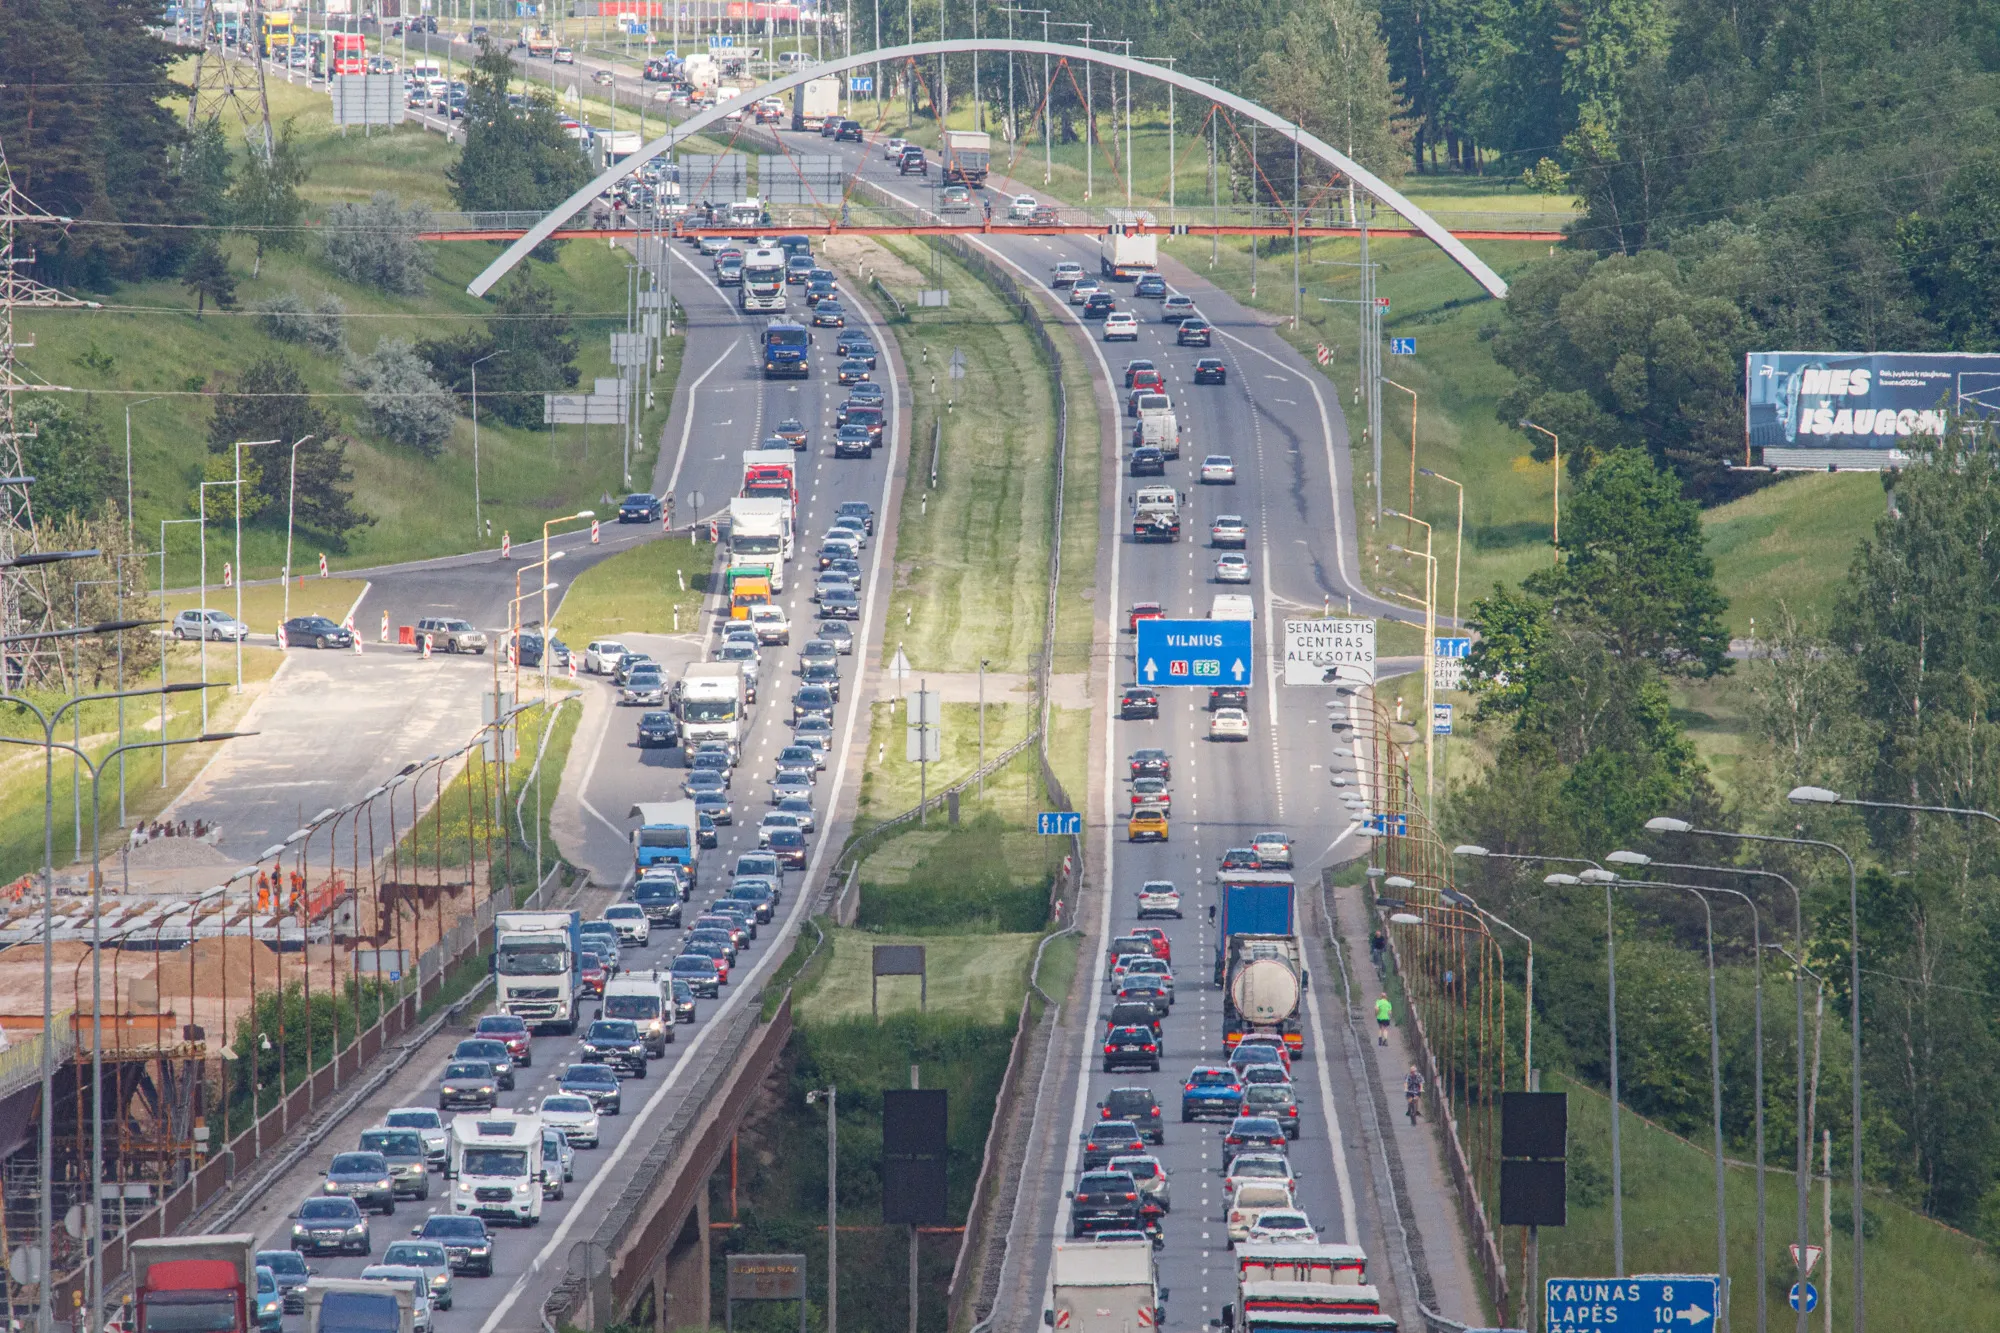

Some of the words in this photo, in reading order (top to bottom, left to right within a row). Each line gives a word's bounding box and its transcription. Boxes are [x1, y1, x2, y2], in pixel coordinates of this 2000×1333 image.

[1801, 369, 1871, 395] MES
[1287, 623, 1374, 635] SENAMIESTIS
[1167, 634, 1223, 647] VILNIUS
[1297, 636, 1363, 648] CENTRAS
[1287, 650, 1373, 663] ALEKSOTAS
[1171, 662, 1187, 675] A1
[1195, 661, 1219, 675] E85
[1550, 1284, 1641, 1302] KAUNAS
[1662, 1286, 1674, 1302] 8
[1550, 1303, 1618, 1324] LAPĖS
[1654, 1306, 1674, 1324] 10
